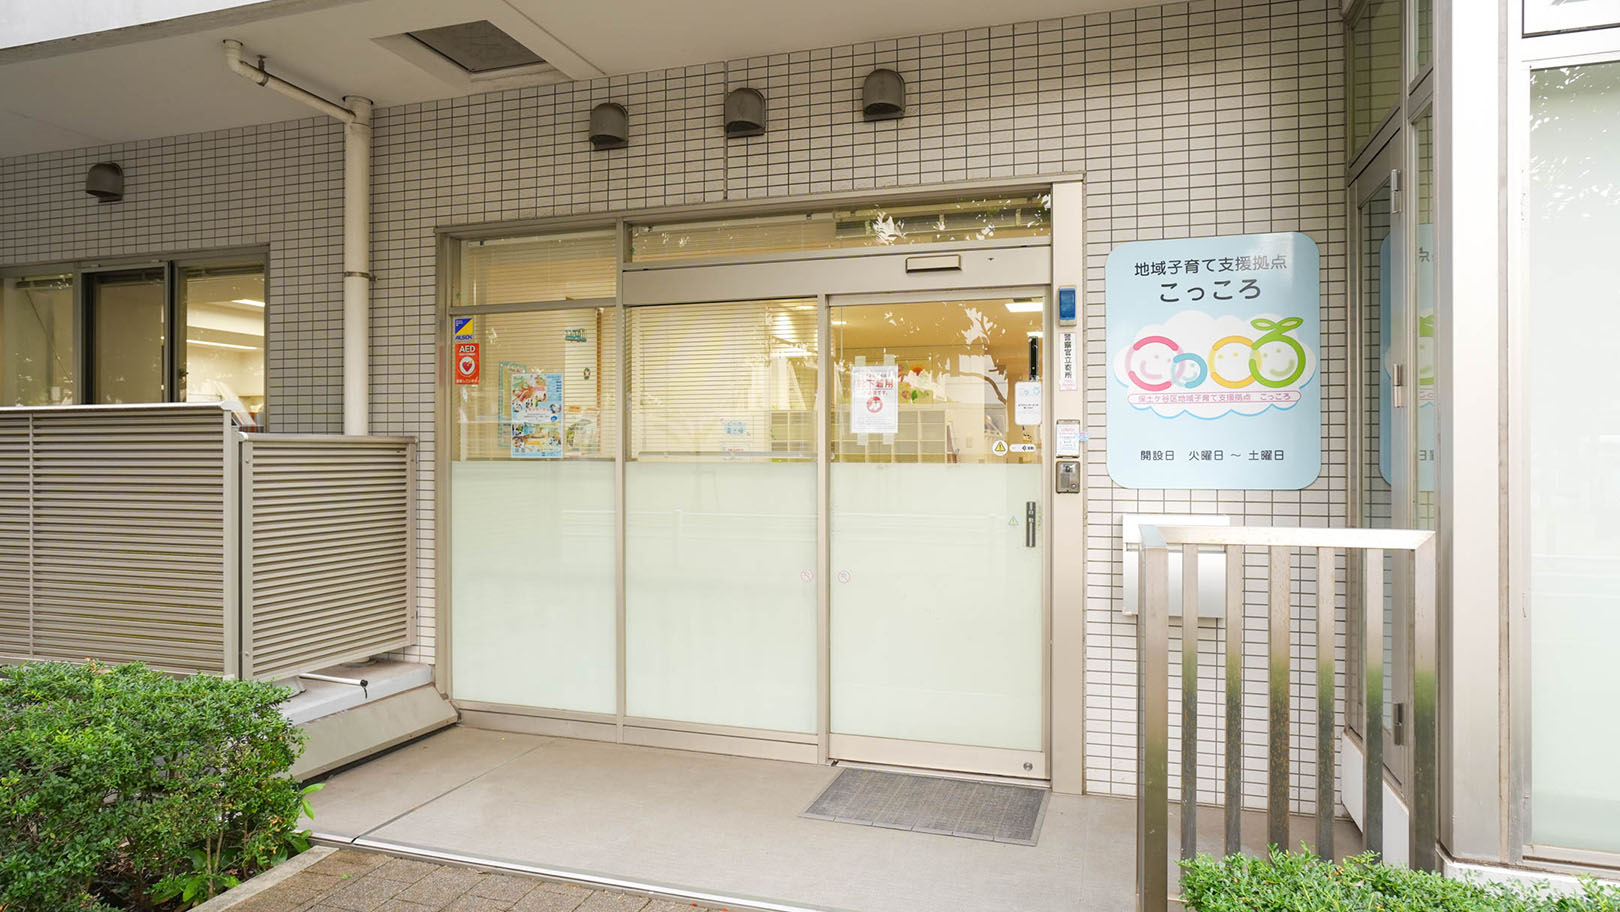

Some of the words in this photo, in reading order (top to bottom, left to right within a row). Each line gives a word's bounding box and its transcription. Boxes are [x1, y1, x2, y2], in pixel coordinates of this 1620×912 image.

[1134, 254, 1288, 277] 地域子育て支援拠点
[1159, 278, 1261, 303] こっころ
[459, 345, 476, 353] AED
[1260, 392, 1292, 401] こっころ
[1140, 449, 1175, 461] 開設日
[1188, 449, 1224, 461] 火曜日
[1247, 449, 1285, 461] 土曜日
